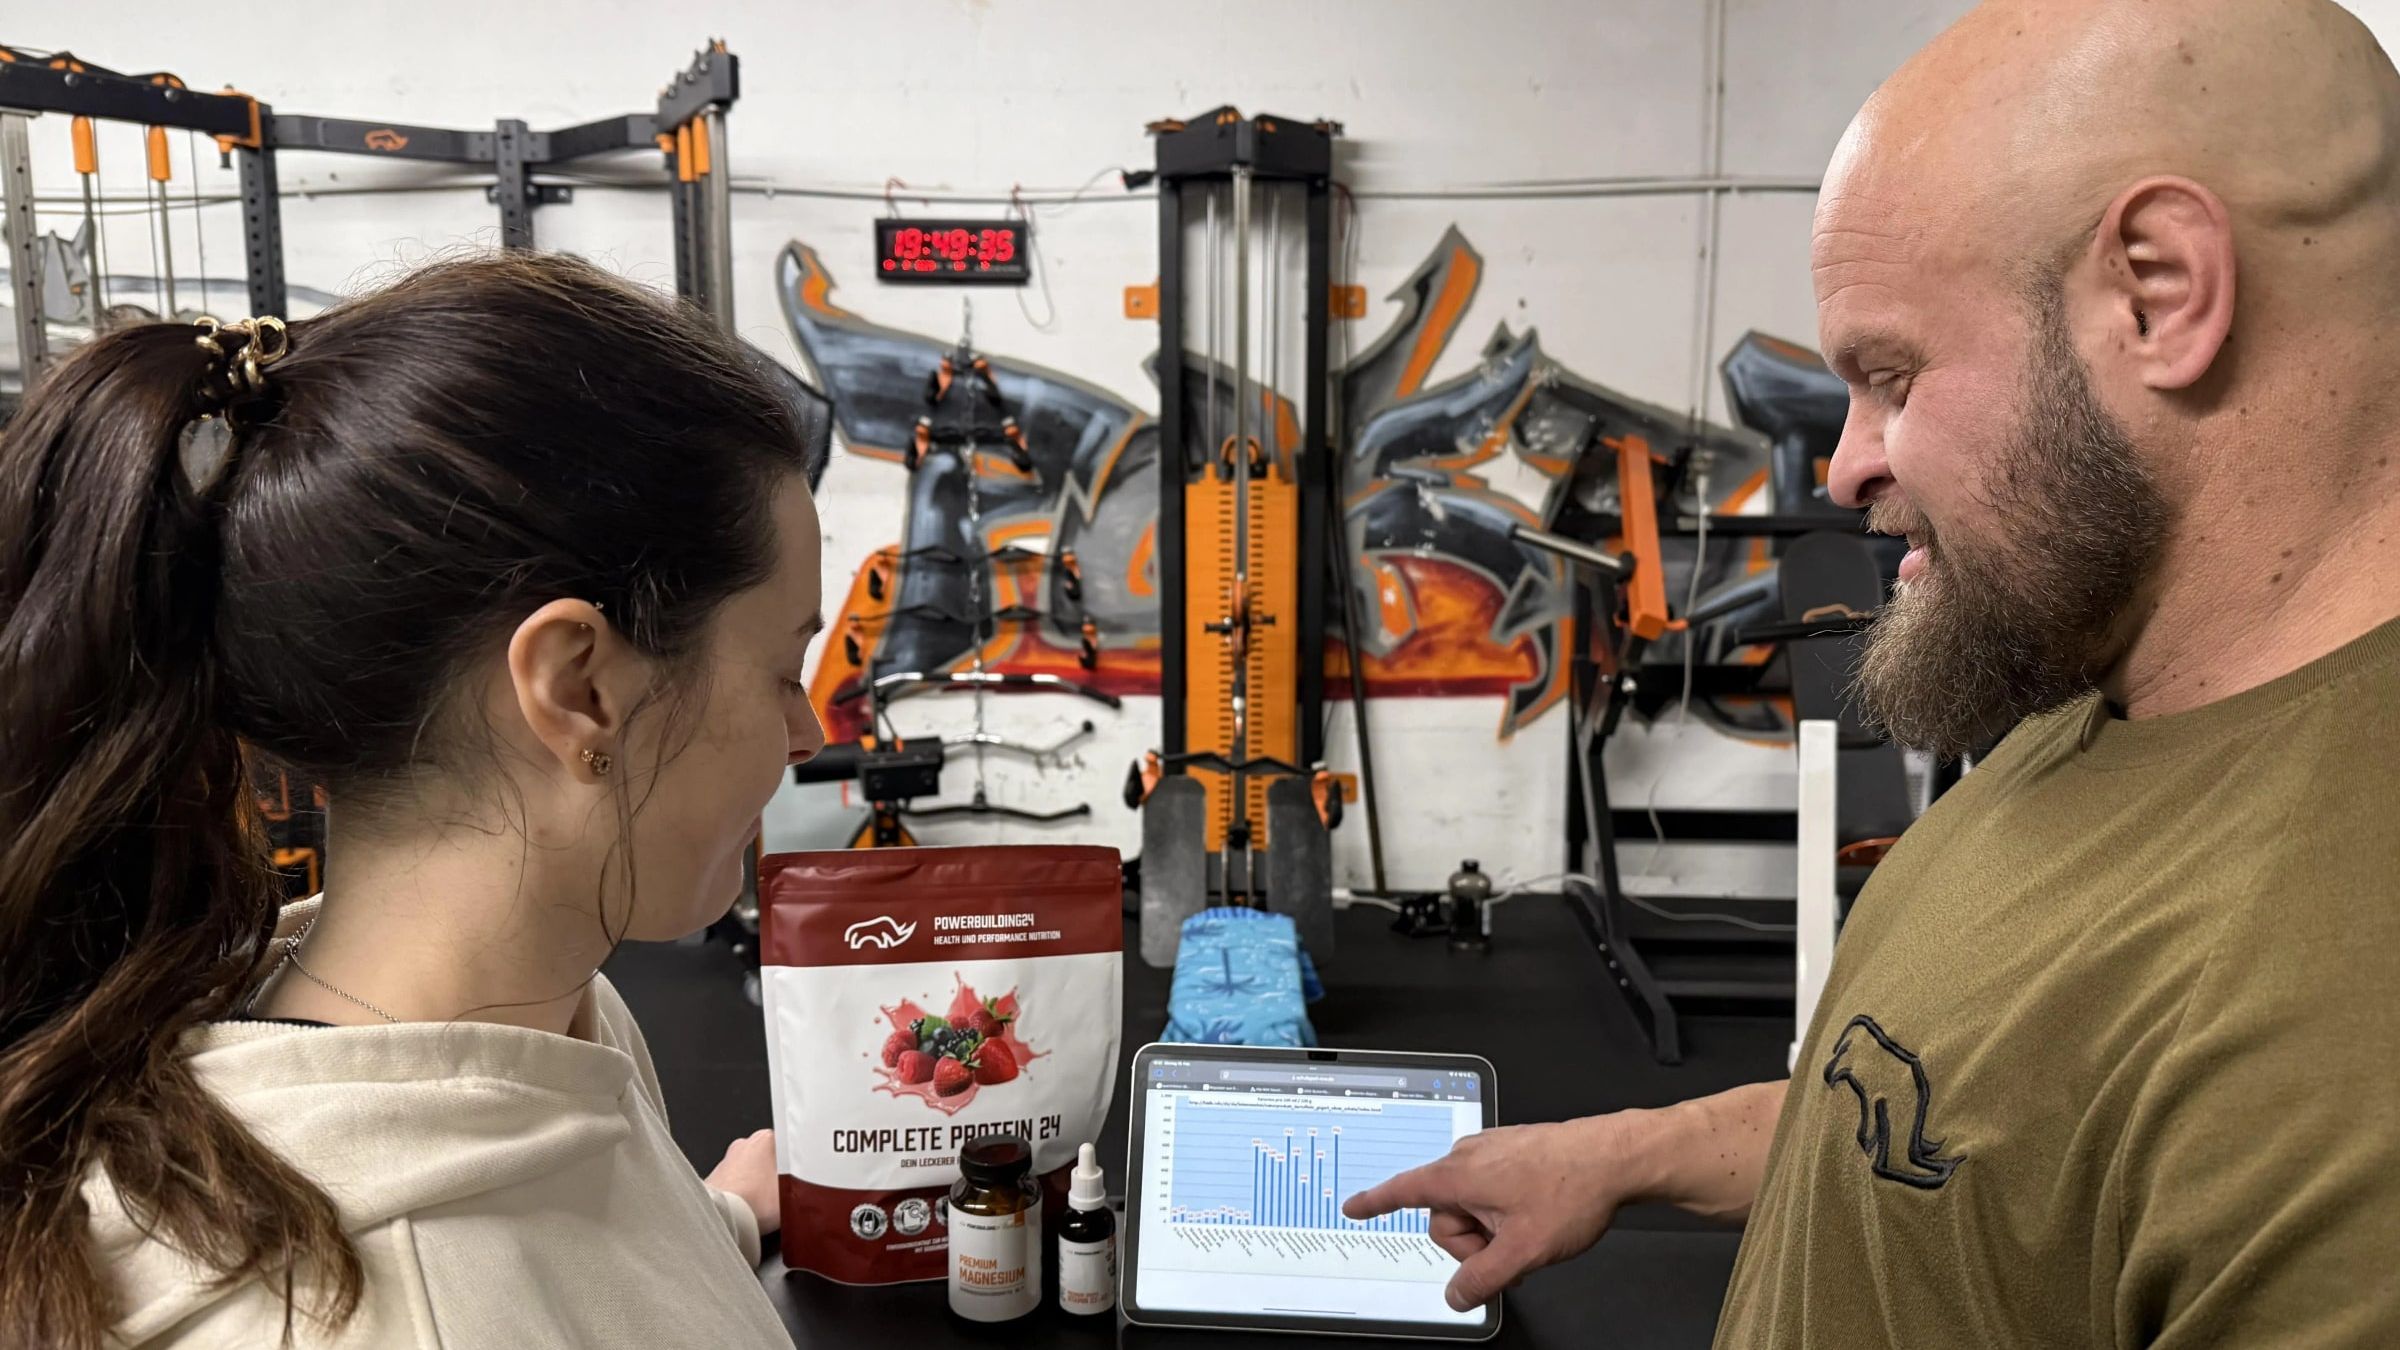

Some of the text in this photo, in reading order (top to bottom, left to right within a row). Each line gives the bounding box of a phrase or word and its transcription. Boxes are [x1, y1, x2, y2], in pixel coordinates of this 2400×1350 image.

[894, 228, 1015, 262] 19:49:35
[934, 913, 1034, 931] POWERBUILDING24
[933, 935, 960, 946] HEALTH
[977, 932, 1028, 944] PERFORMANCE
[1028, 930, 1061, 941] NUTRITION
[833, 1127, 942, 1153] COMPLETE
[1039, 1114, 1061, 1141] 24
[900, 1158, 918, 1169] DEIN
[919, 1156, 956, 1168] LECKERER
[960, 1255, 998, 1269] PREMIUM
[959, 1267, 1025, 1286] MAGNESIUM
